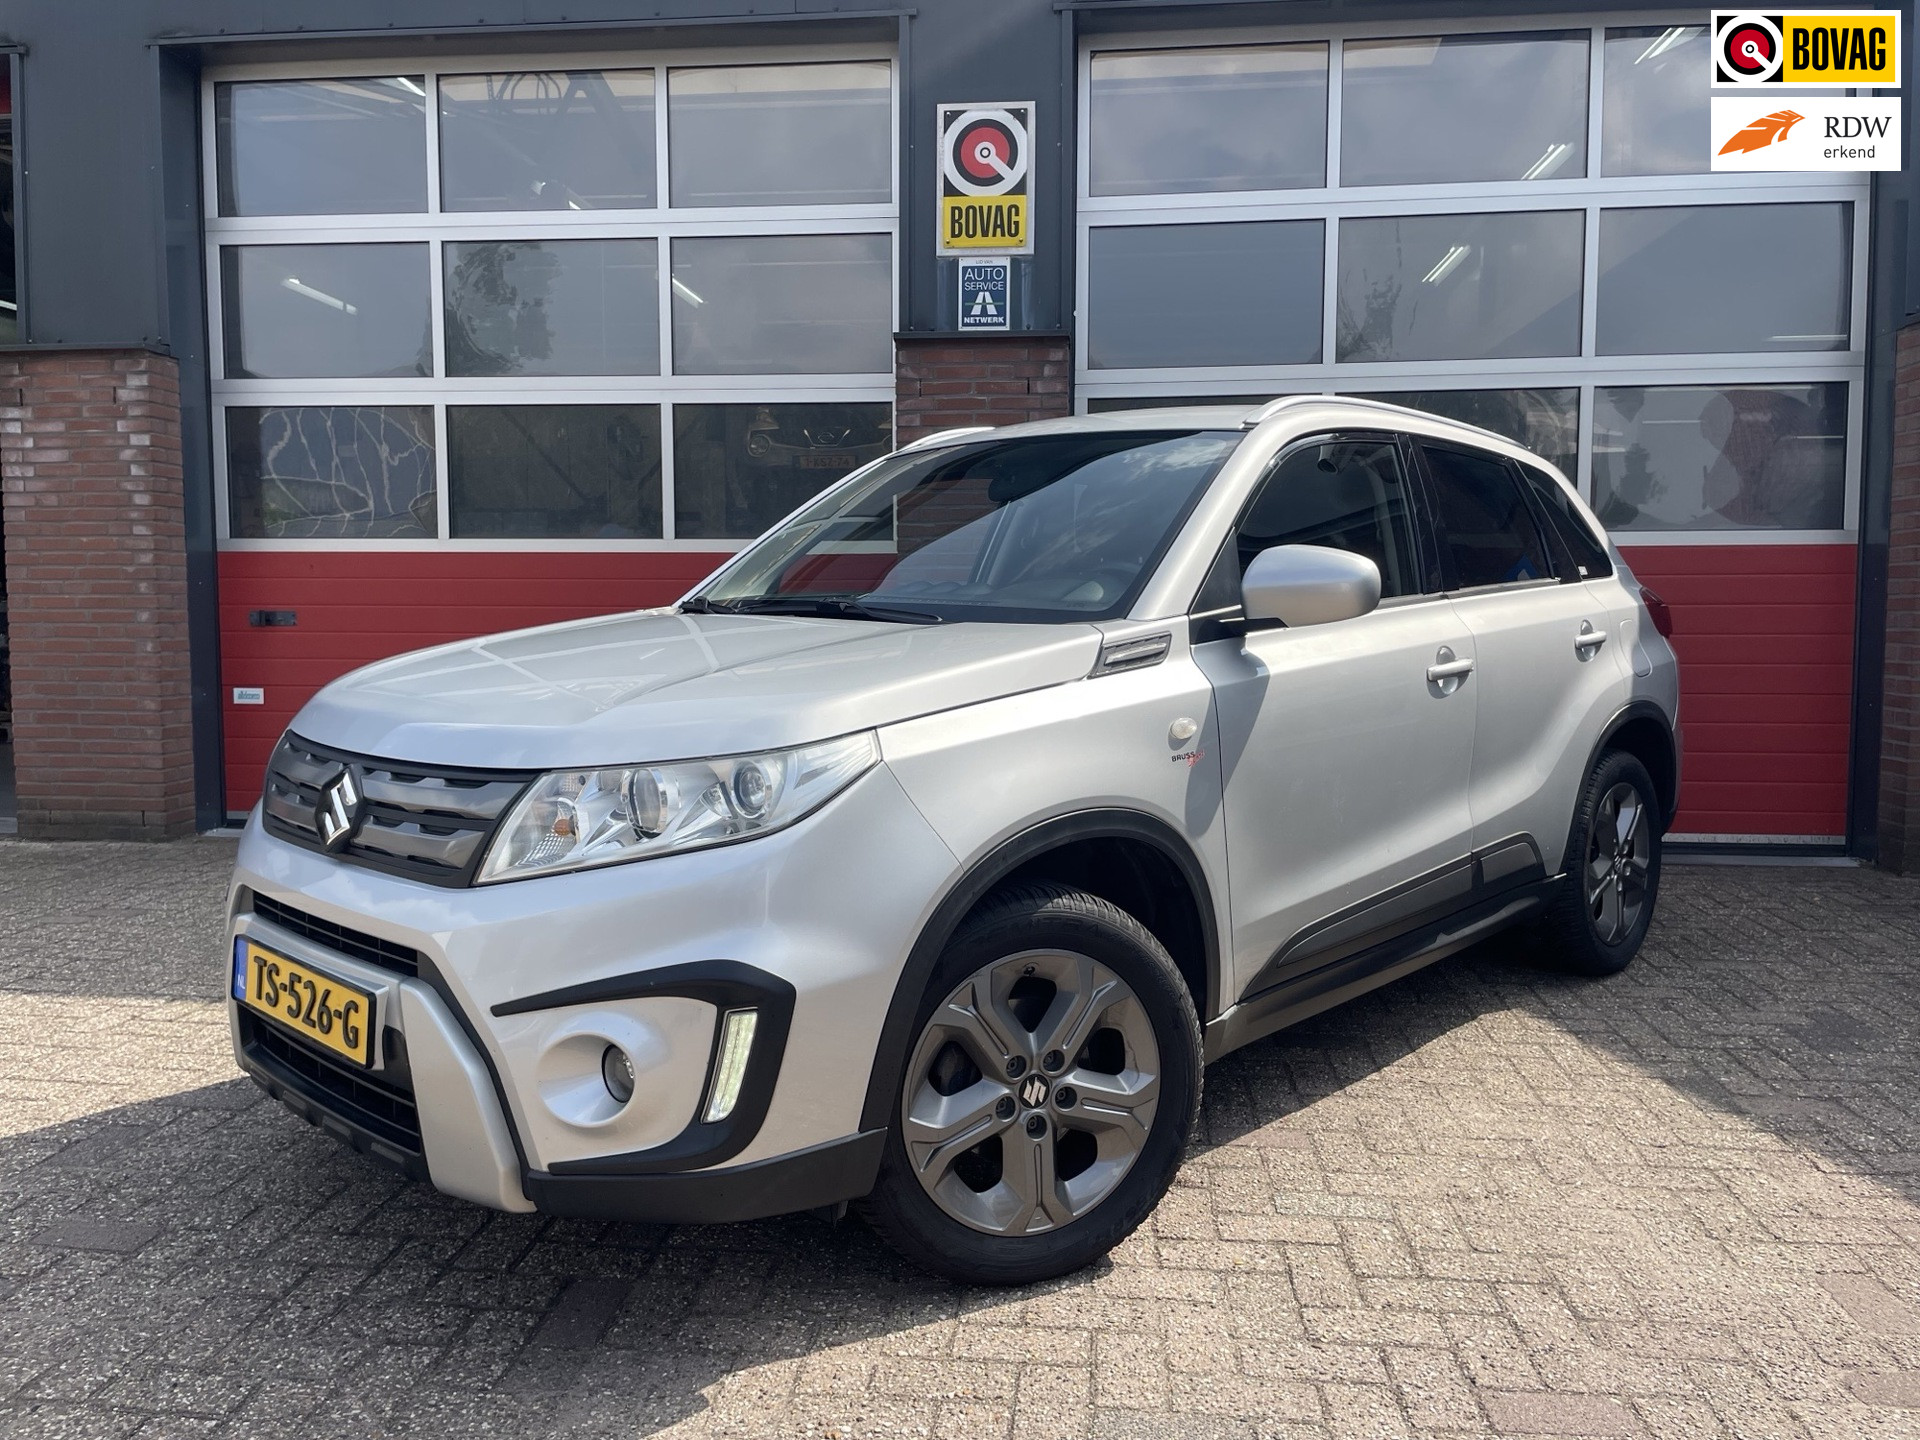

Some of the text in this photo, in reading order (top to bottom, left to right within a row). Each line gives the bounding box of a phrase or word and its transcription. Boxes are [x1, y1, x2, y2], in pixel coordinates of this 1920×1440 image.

[950, 203, 1020, 239] BOVAG
[964, 267, 1004, 281] AUTO
[964, 281, 1004, 291] SERVICE
[963, 316, 1005, 324] NETWERK
[253, 955, 359, 1050] TS-526-G
